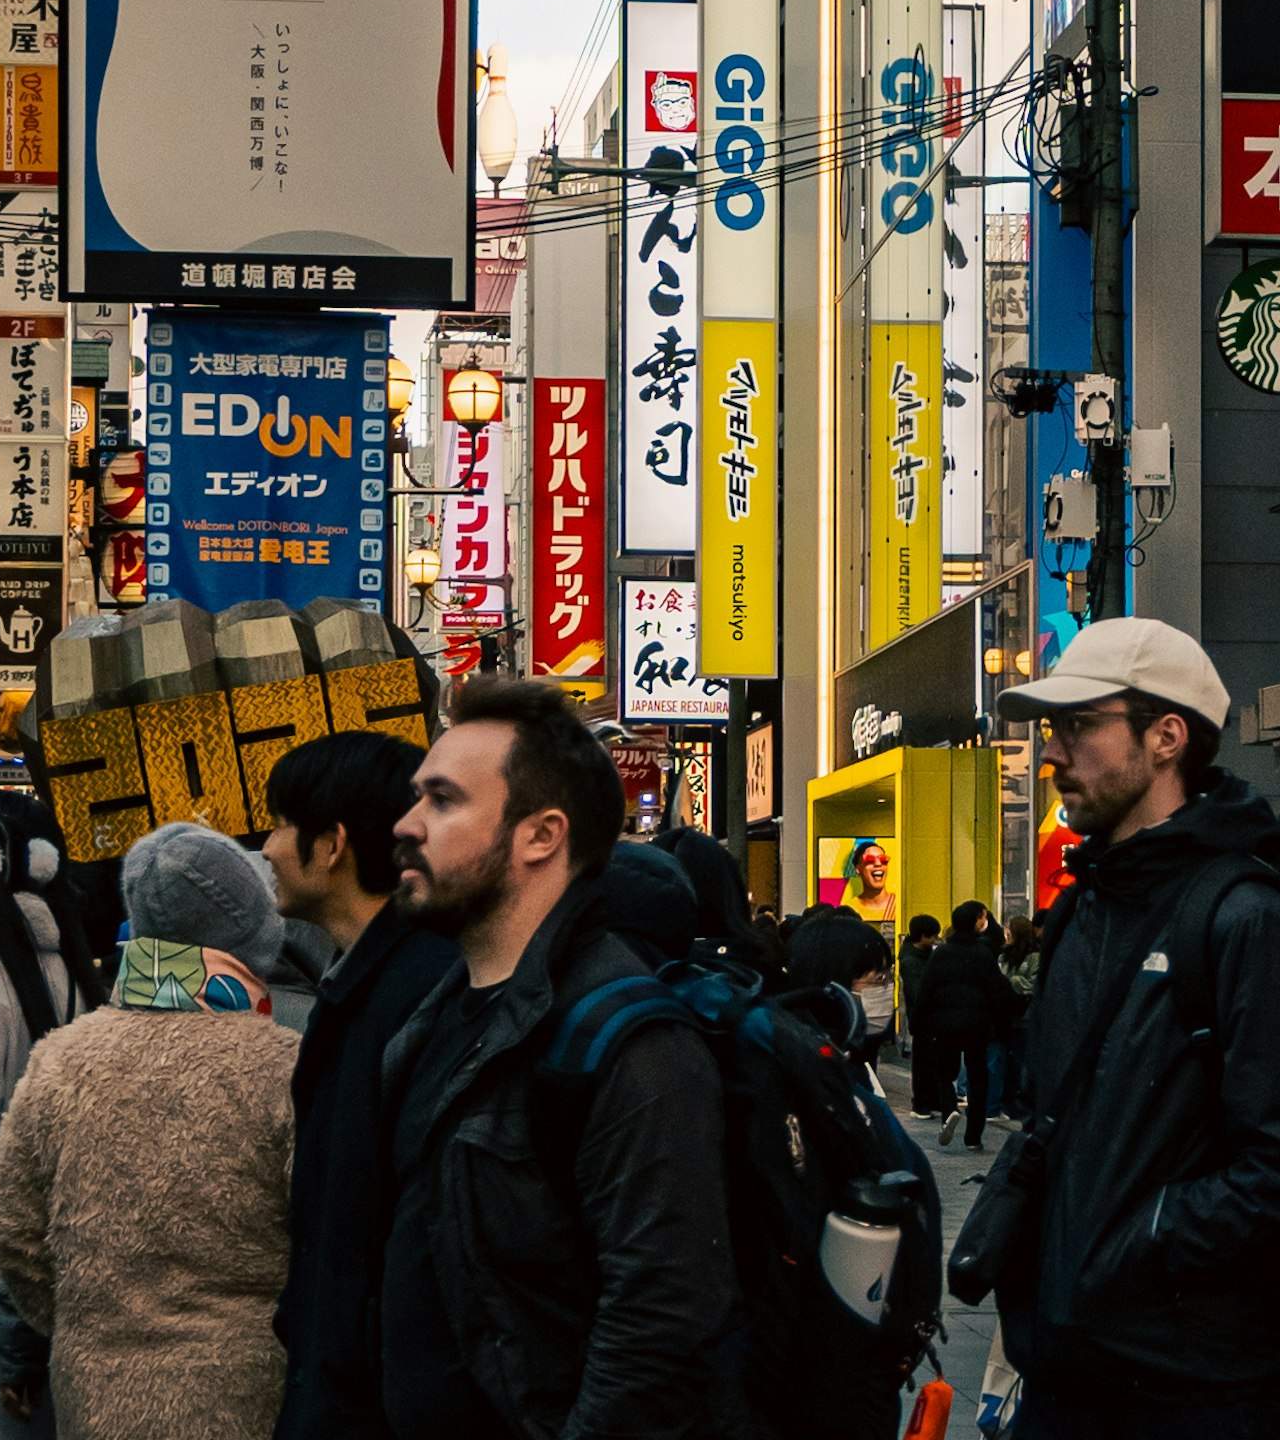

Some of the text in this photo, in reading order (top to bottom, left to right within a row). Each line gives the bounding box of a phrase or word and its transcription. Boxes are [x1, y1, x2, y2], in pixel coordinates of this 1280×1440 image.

[19, 71, 43, 165] 鳥貴族
[13, 172, 33, 184] 3F
[181, 262, 357, 290] 道頓堀商店会
[10, 320, 36, 337] 2F
[189, 353, 348, 379] 大型家電専門店
[181, 392, 352, 458] EDION
[719, 358, 761, 523] マツモトキヨシ
[204, 470, 328, 498] エディオン
[548, 385, 589, 641] ツルハドラッグ
[238, 519, 311, 533] DOTONBORI
[315, 523, 349, 536] Japan
[0, 589, 42, 599] COFFEE
[25, 580, 51, 589] DRIP
[728, 543, 748, 642] matsukiyo
[635, 587, 697, 613] お食
[630, 699, 678, 714] JAPANESE
